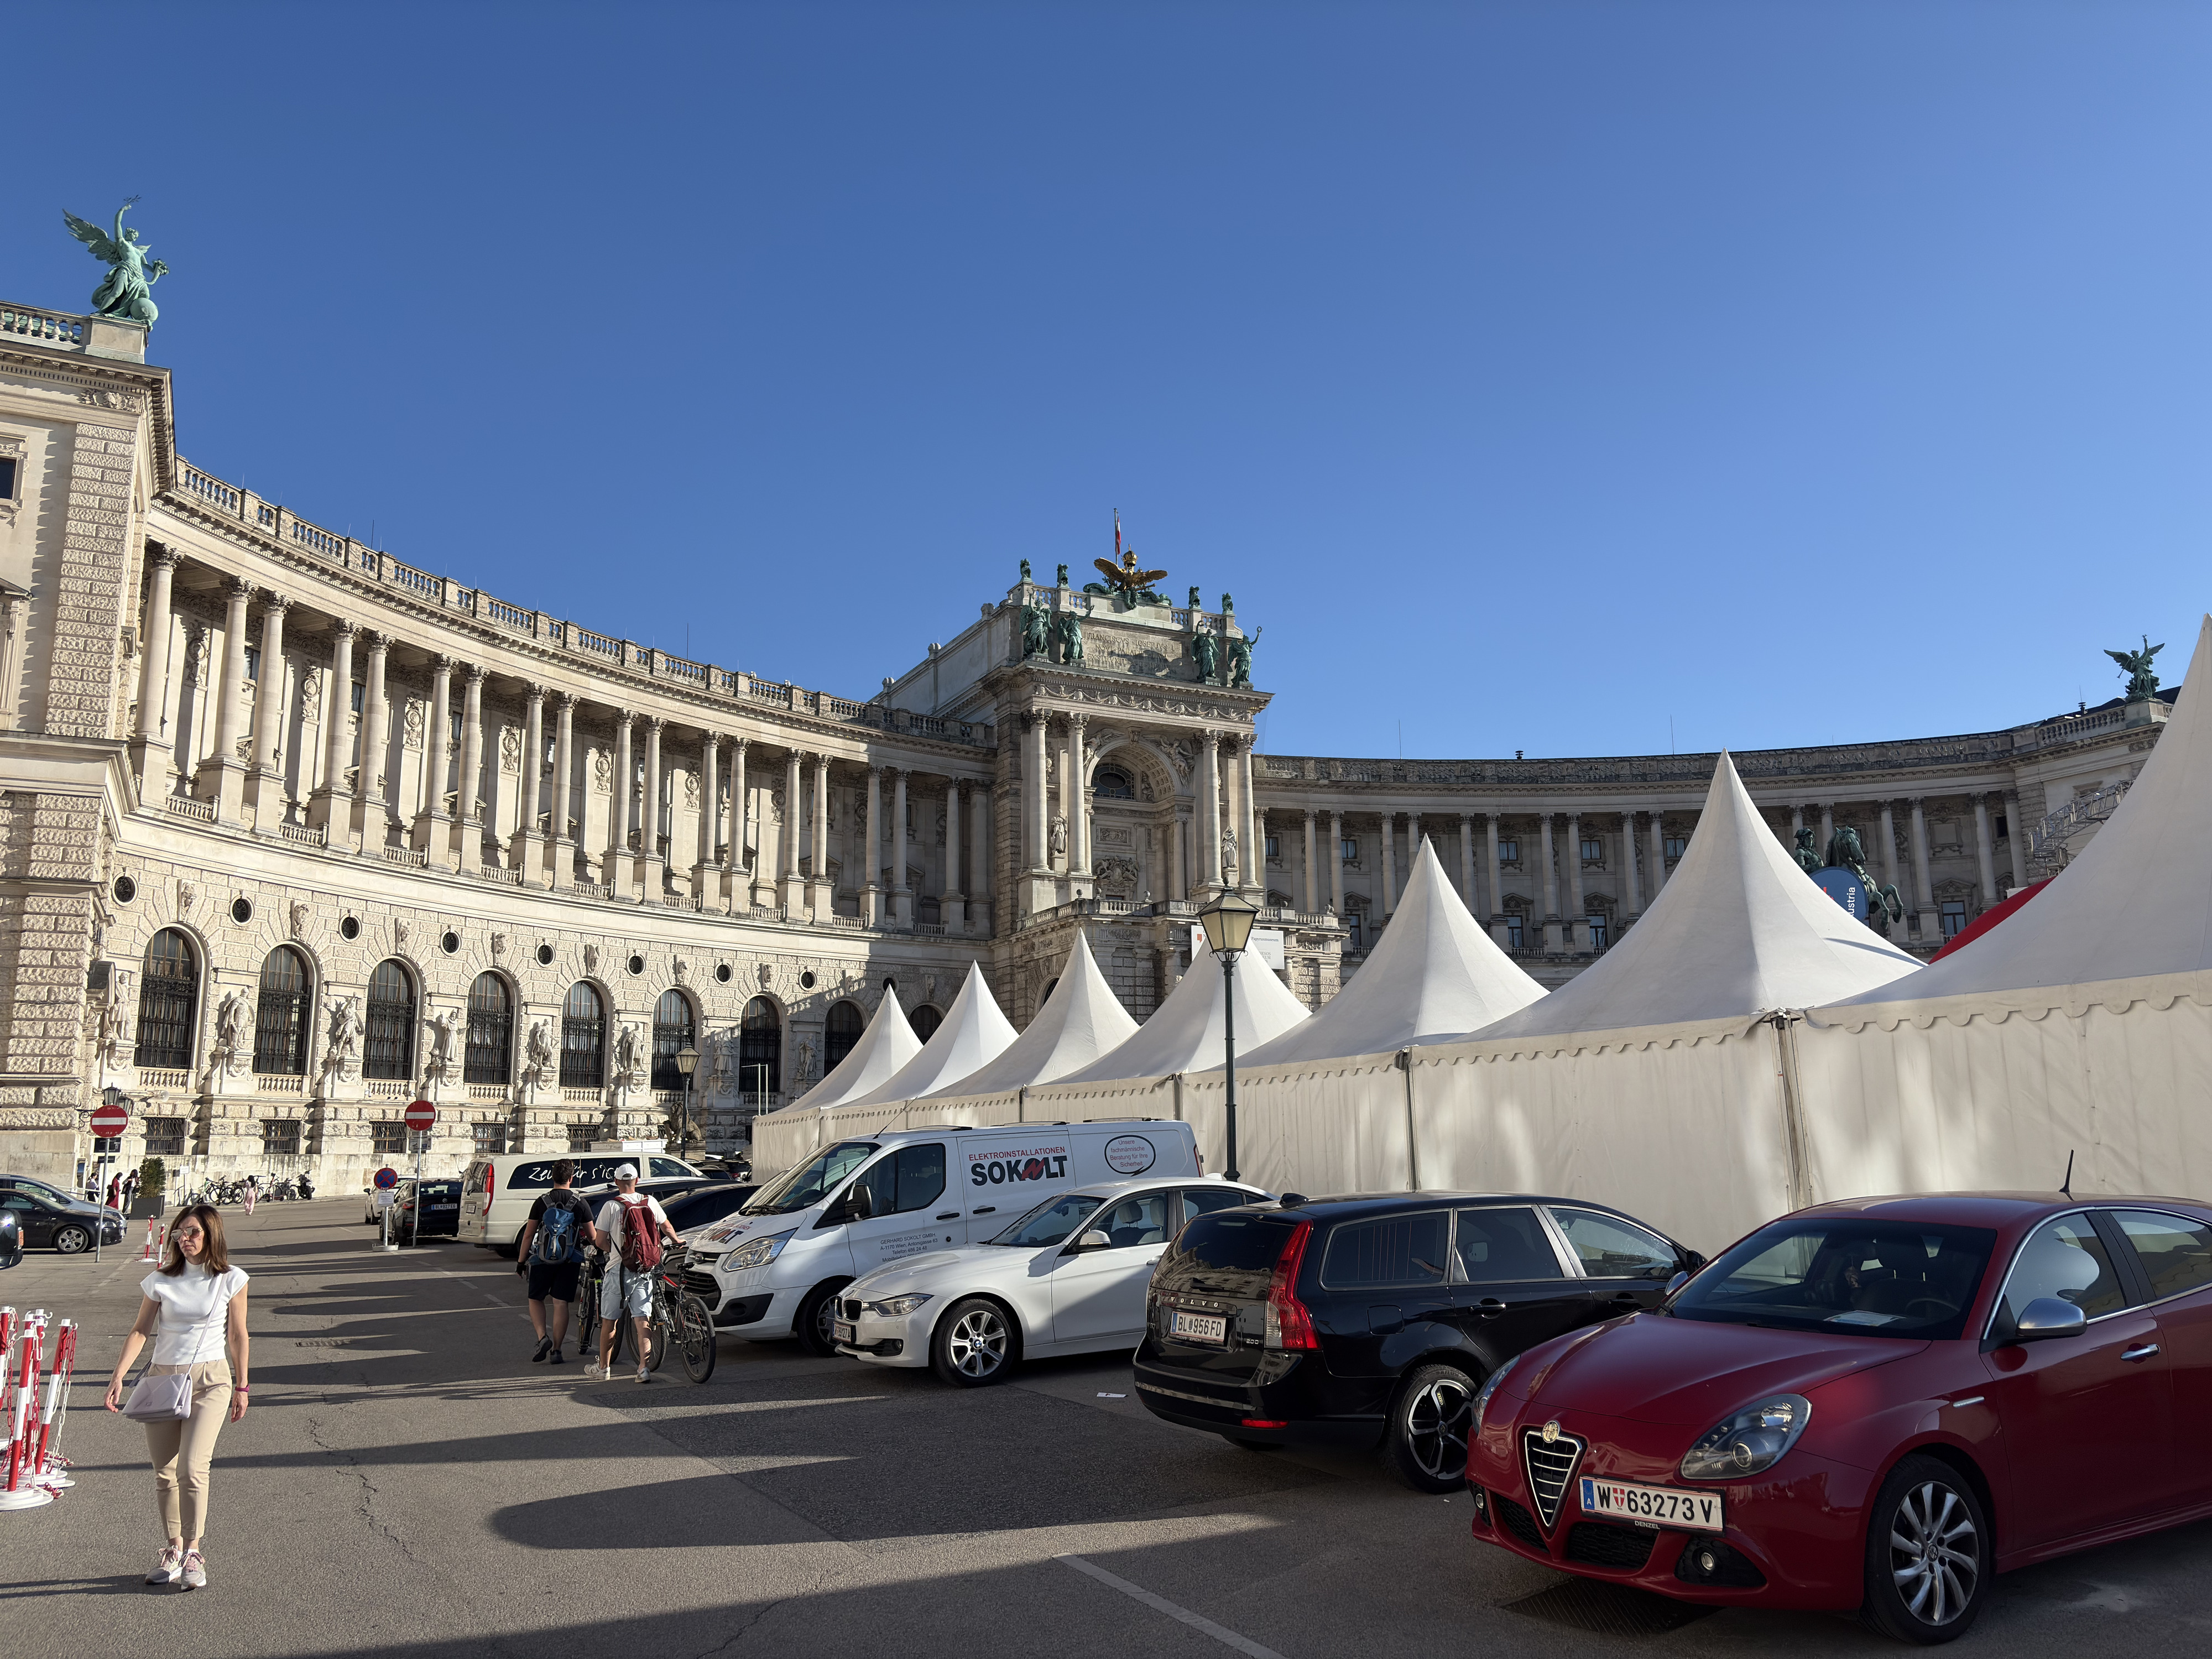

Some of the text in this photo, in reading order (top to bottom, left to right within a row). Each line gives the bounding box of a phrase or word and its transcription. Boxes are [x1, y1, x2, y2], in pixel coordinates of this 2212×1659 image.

[1846, 887, 1855, 916] ustria
[969, 1146, 1066, 1161] ELEKTROINSTALLATIONEN
[528, 1165, 555, 1181] Zei
[573, 1165, 587, 1179] ür
[971, 1155, 1068, 1186] SOKOLT
[1171, 1297, 1219, 1308] VOLVO
[1178, 1316, 1187, 1332] BL
[1193, 1318, 1209, 1336] 956
[1210, 1321, 1222, 1337] FD
[1597, 1485, 1610, 1509] W
[1627, 1490, 1695, 1521] 63273
[1700, 1499, 1712, 1523] V
[1635, 1521, 1660, 1530] DENZEL
